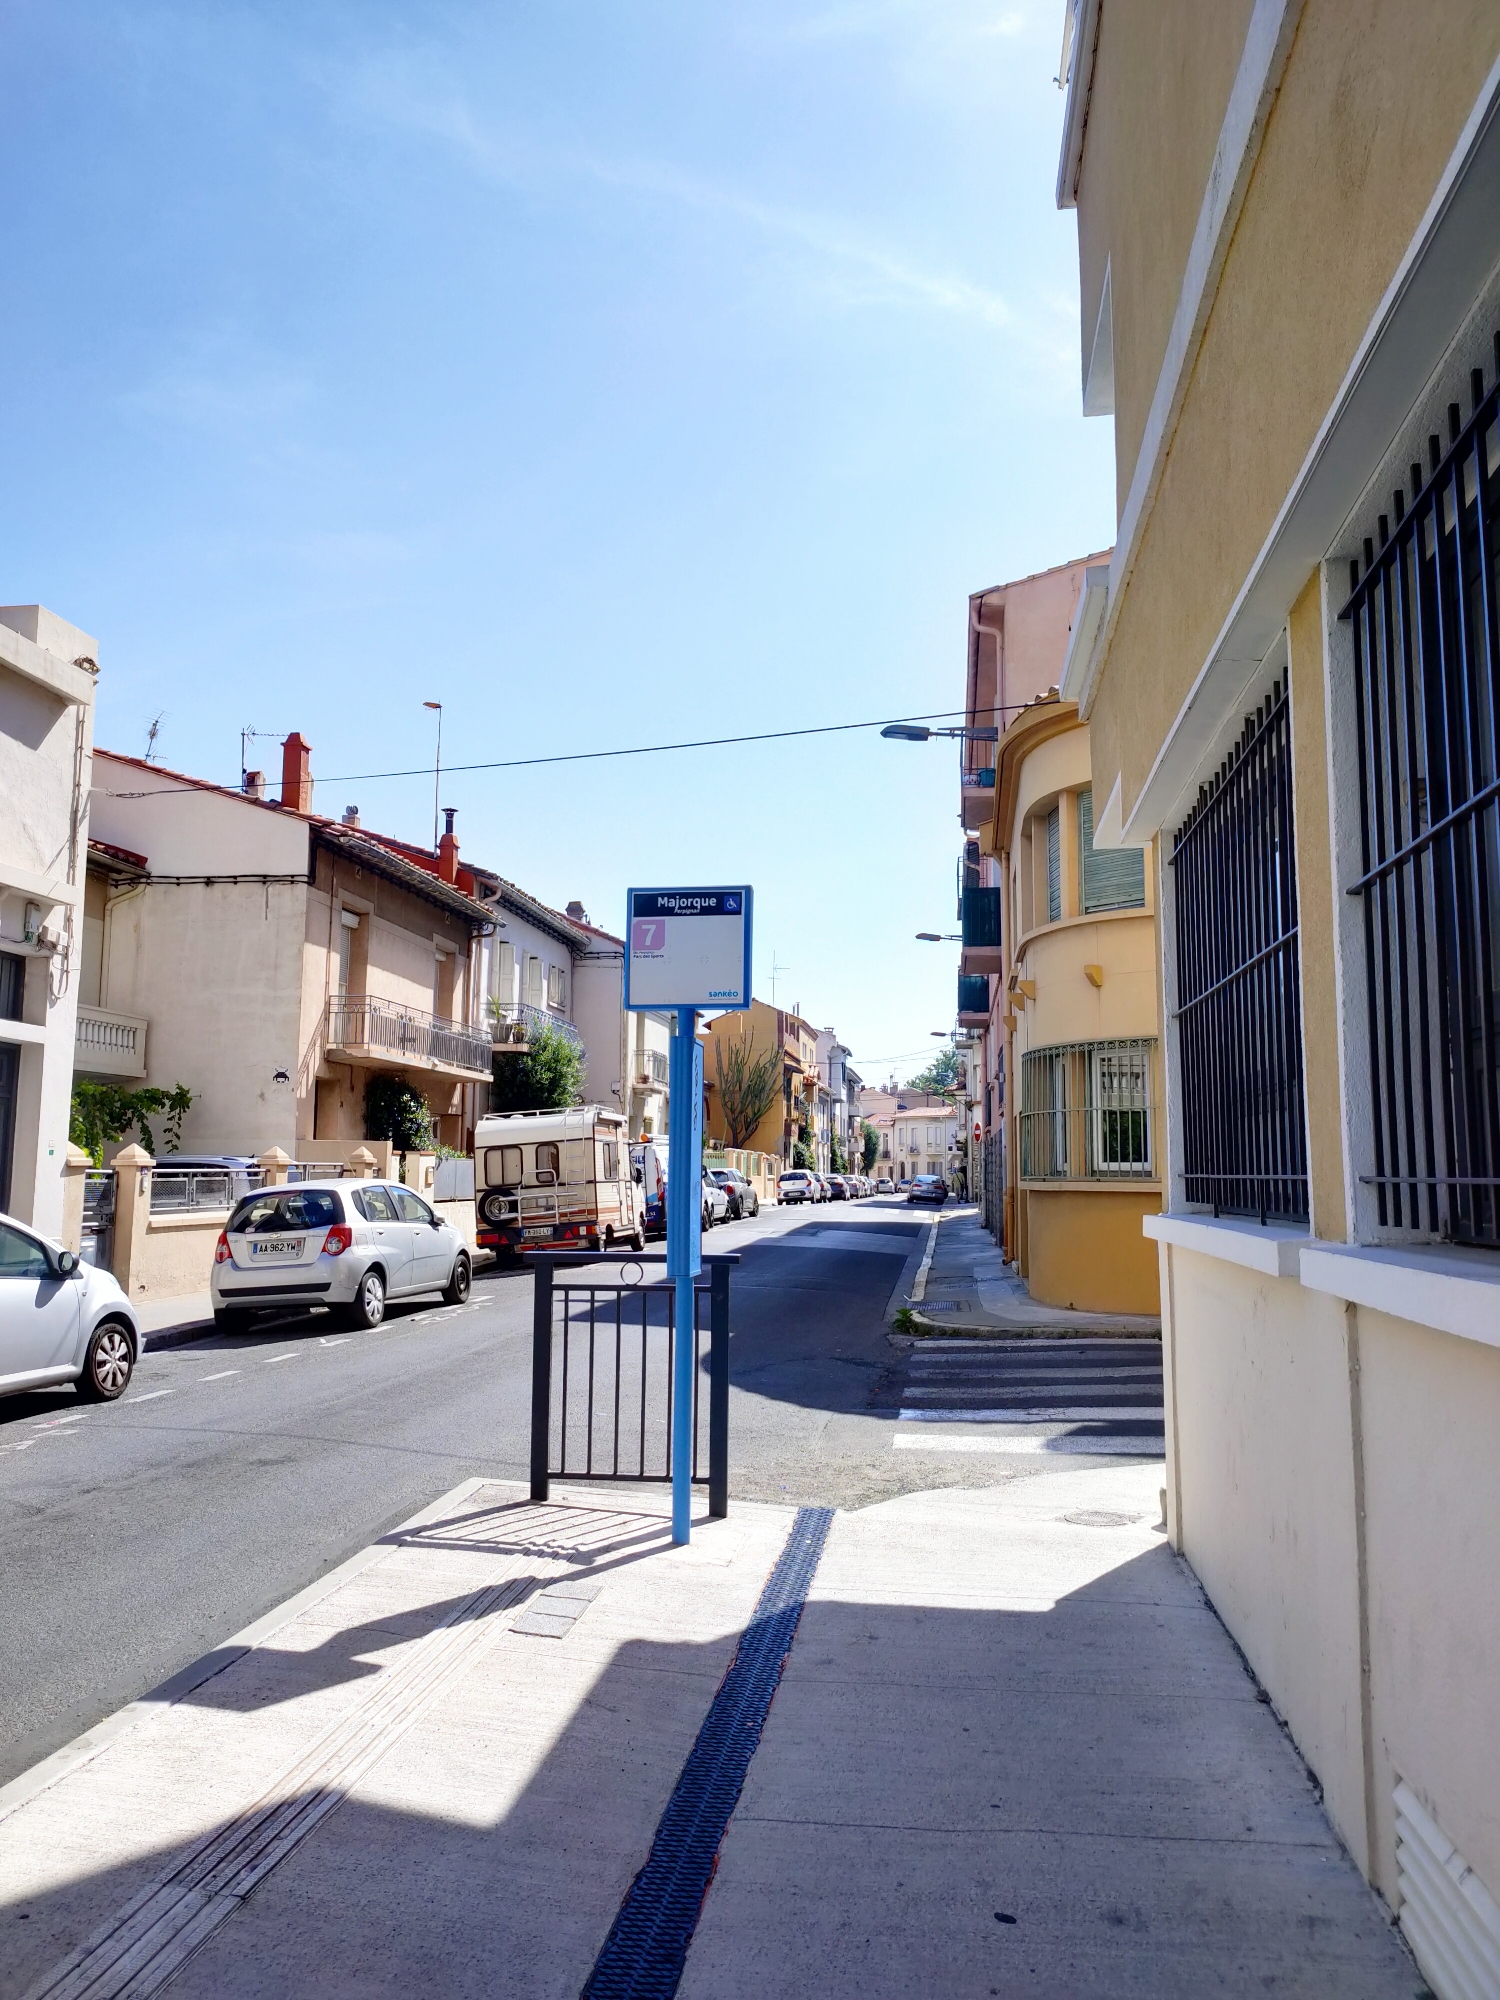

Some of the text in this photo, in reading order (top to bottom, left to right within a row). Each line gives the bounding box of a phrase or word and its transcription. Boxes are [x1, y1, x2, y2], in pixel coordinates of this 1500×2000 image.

[658, 895, 717, 909] Majorque
[641, 924, 657, 946] 7
[708, 989, 739, 998] sankéo
